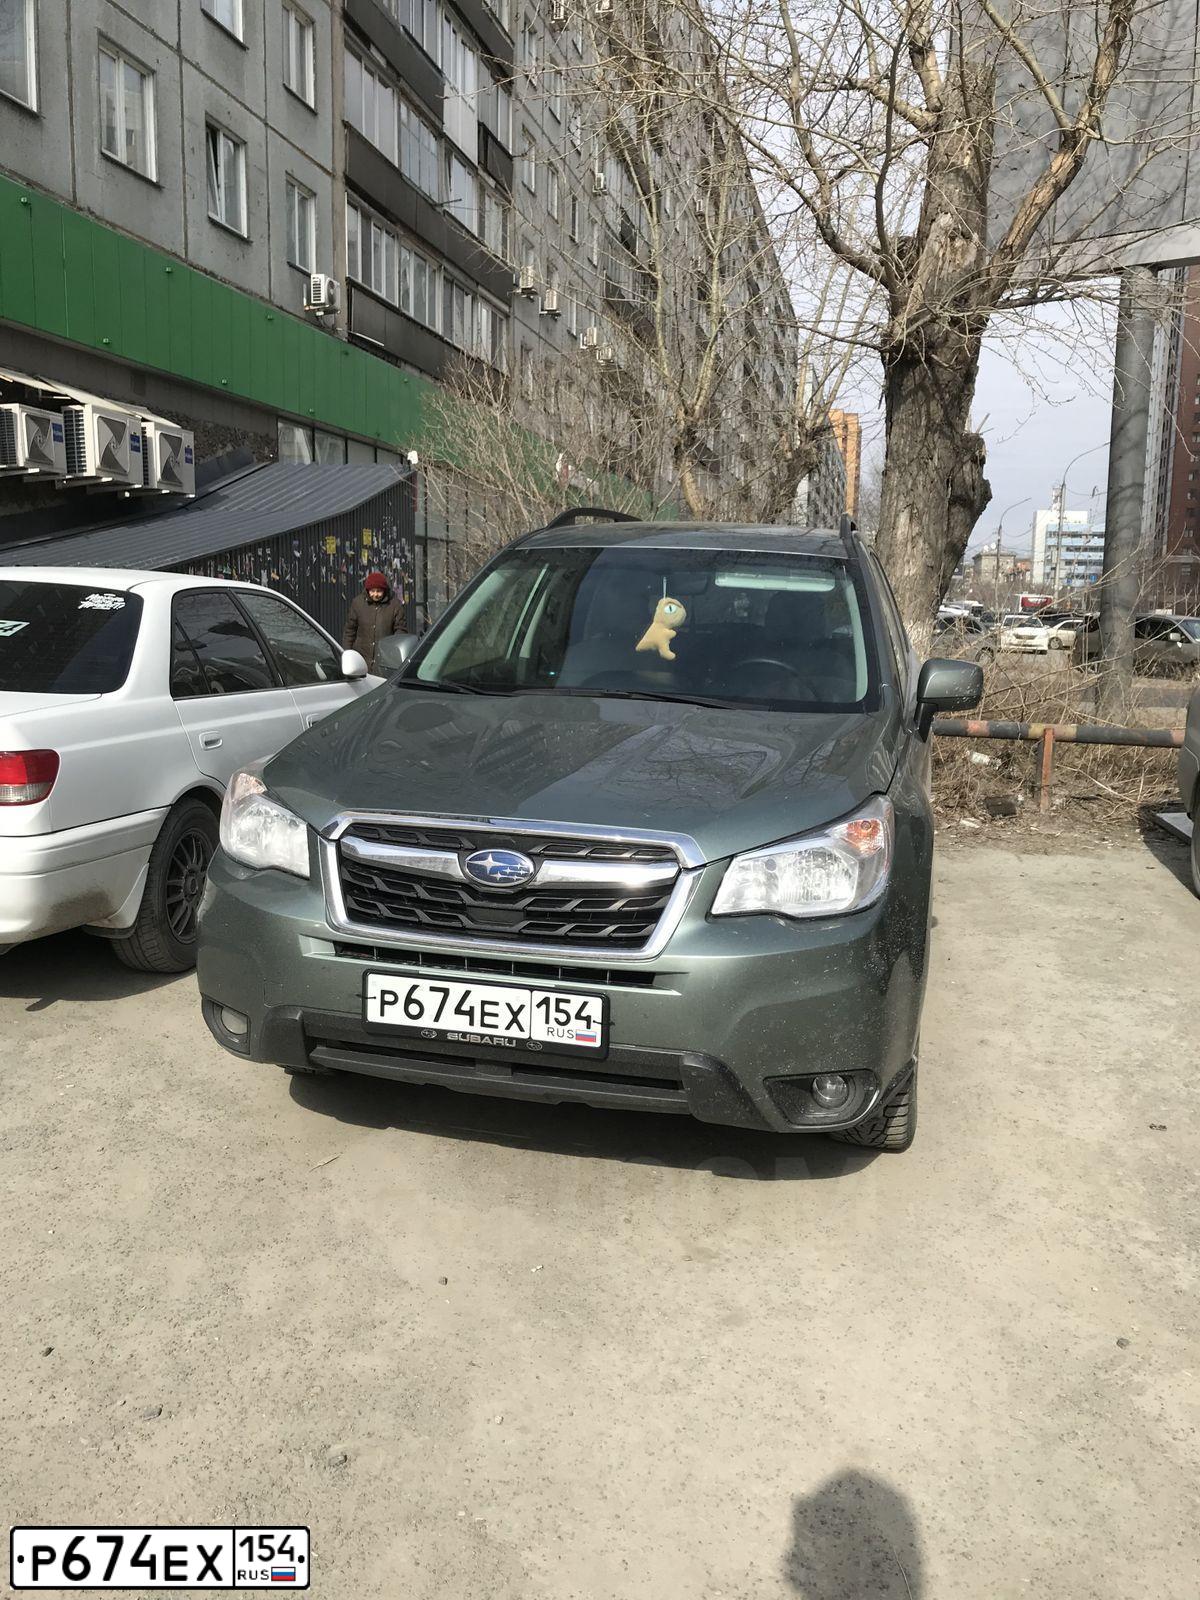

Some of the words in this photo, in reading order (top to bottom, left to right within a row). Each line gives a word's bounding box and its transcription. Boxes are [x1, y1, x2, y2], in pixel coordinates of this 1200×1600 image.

[535, 996, 593, 1030] 154
[446, 1032, 517, 1049] SUBARU
[546, 1026, 575, 1040] RUS
